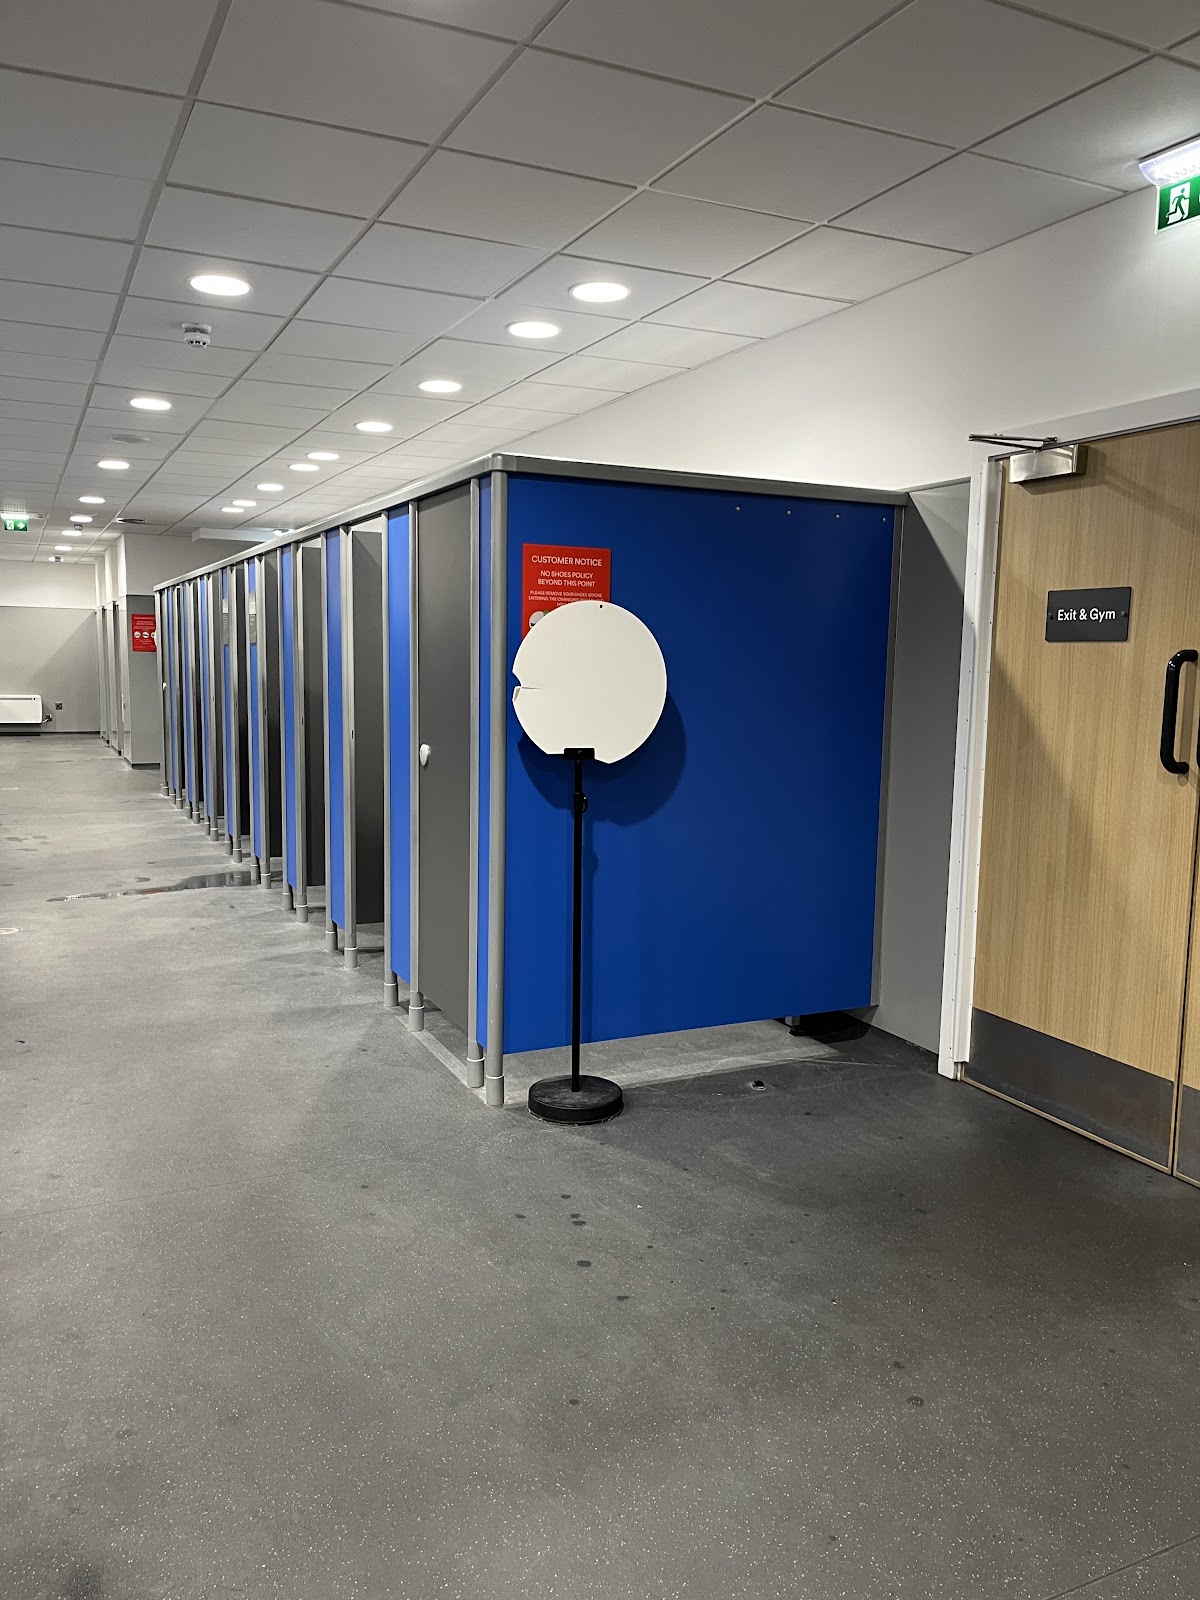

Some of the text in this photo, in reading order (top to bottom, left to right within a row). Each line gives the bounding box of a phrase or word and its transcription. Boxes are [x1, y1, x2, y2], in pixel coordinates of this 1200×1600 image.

[531, 555, 602, 566] CUSTOMER NOTICE
[551, 570, 572, 578] SHOES
[572, 571, 594, 579] POLICY
[1057, 607, 1116, 622] Exit & Gym
